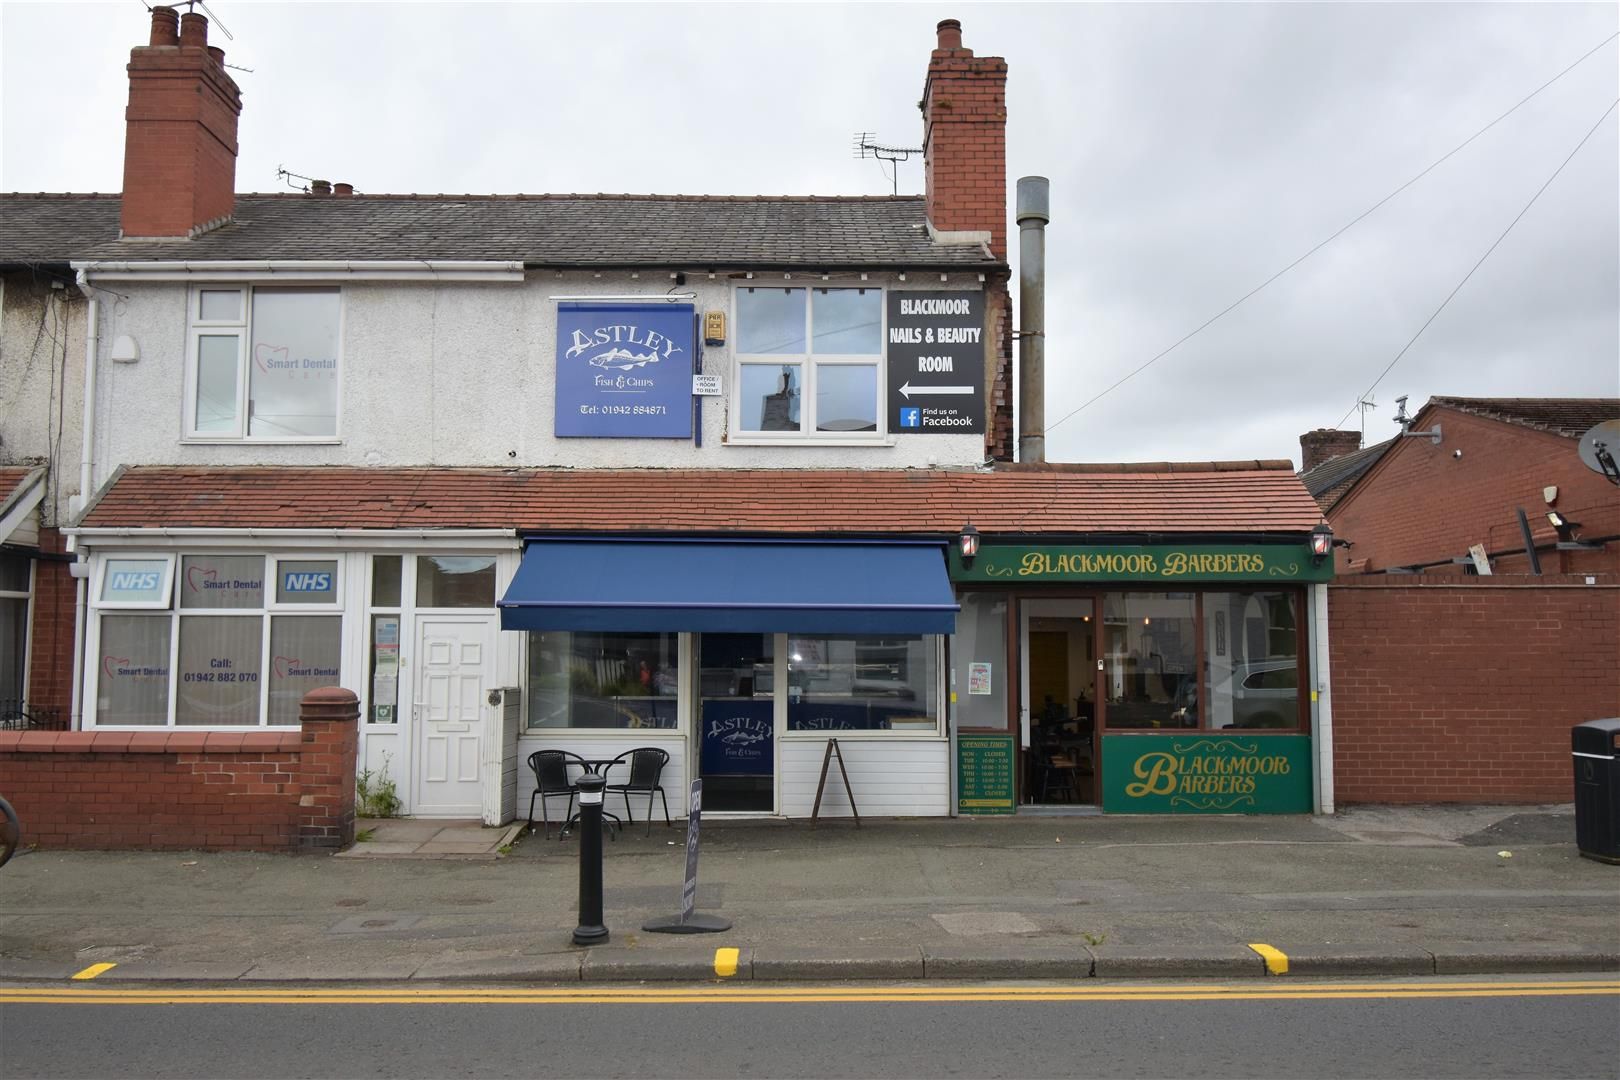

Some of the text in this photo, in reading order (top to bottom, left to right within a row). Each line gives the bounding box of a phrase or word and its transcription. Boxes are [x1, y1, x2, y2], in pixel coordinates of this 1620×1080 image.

[900, 299, 970, 315] BLACKMOOR
[889, 327, 981, 343] NAILS & BEAUTY
[565, 325, 683, 359] ASTLEY
[266, 358, 336, 369] Smart Dental
[918, 356, 953, 372] ROOM
[615, 375, 625, 389] &
[580, 404, 667, 415] Tel: 01942 884871
[922, 416, 973, 426] Facebook
[1018, 552, 1264, 576] BLACKMOOR BARBERS
[112, 573, 159, 589] NHS
[203, 580, 262, 589] Smart Dental
[286, 573, 330, 590] NHS
[210, 658, 232, 669] Call:
[118, 668, 169, 676] Smart Dental
[184, 673, 258, 682] 01942 882 070
[288, 668, 338, 676] Smart Dental
